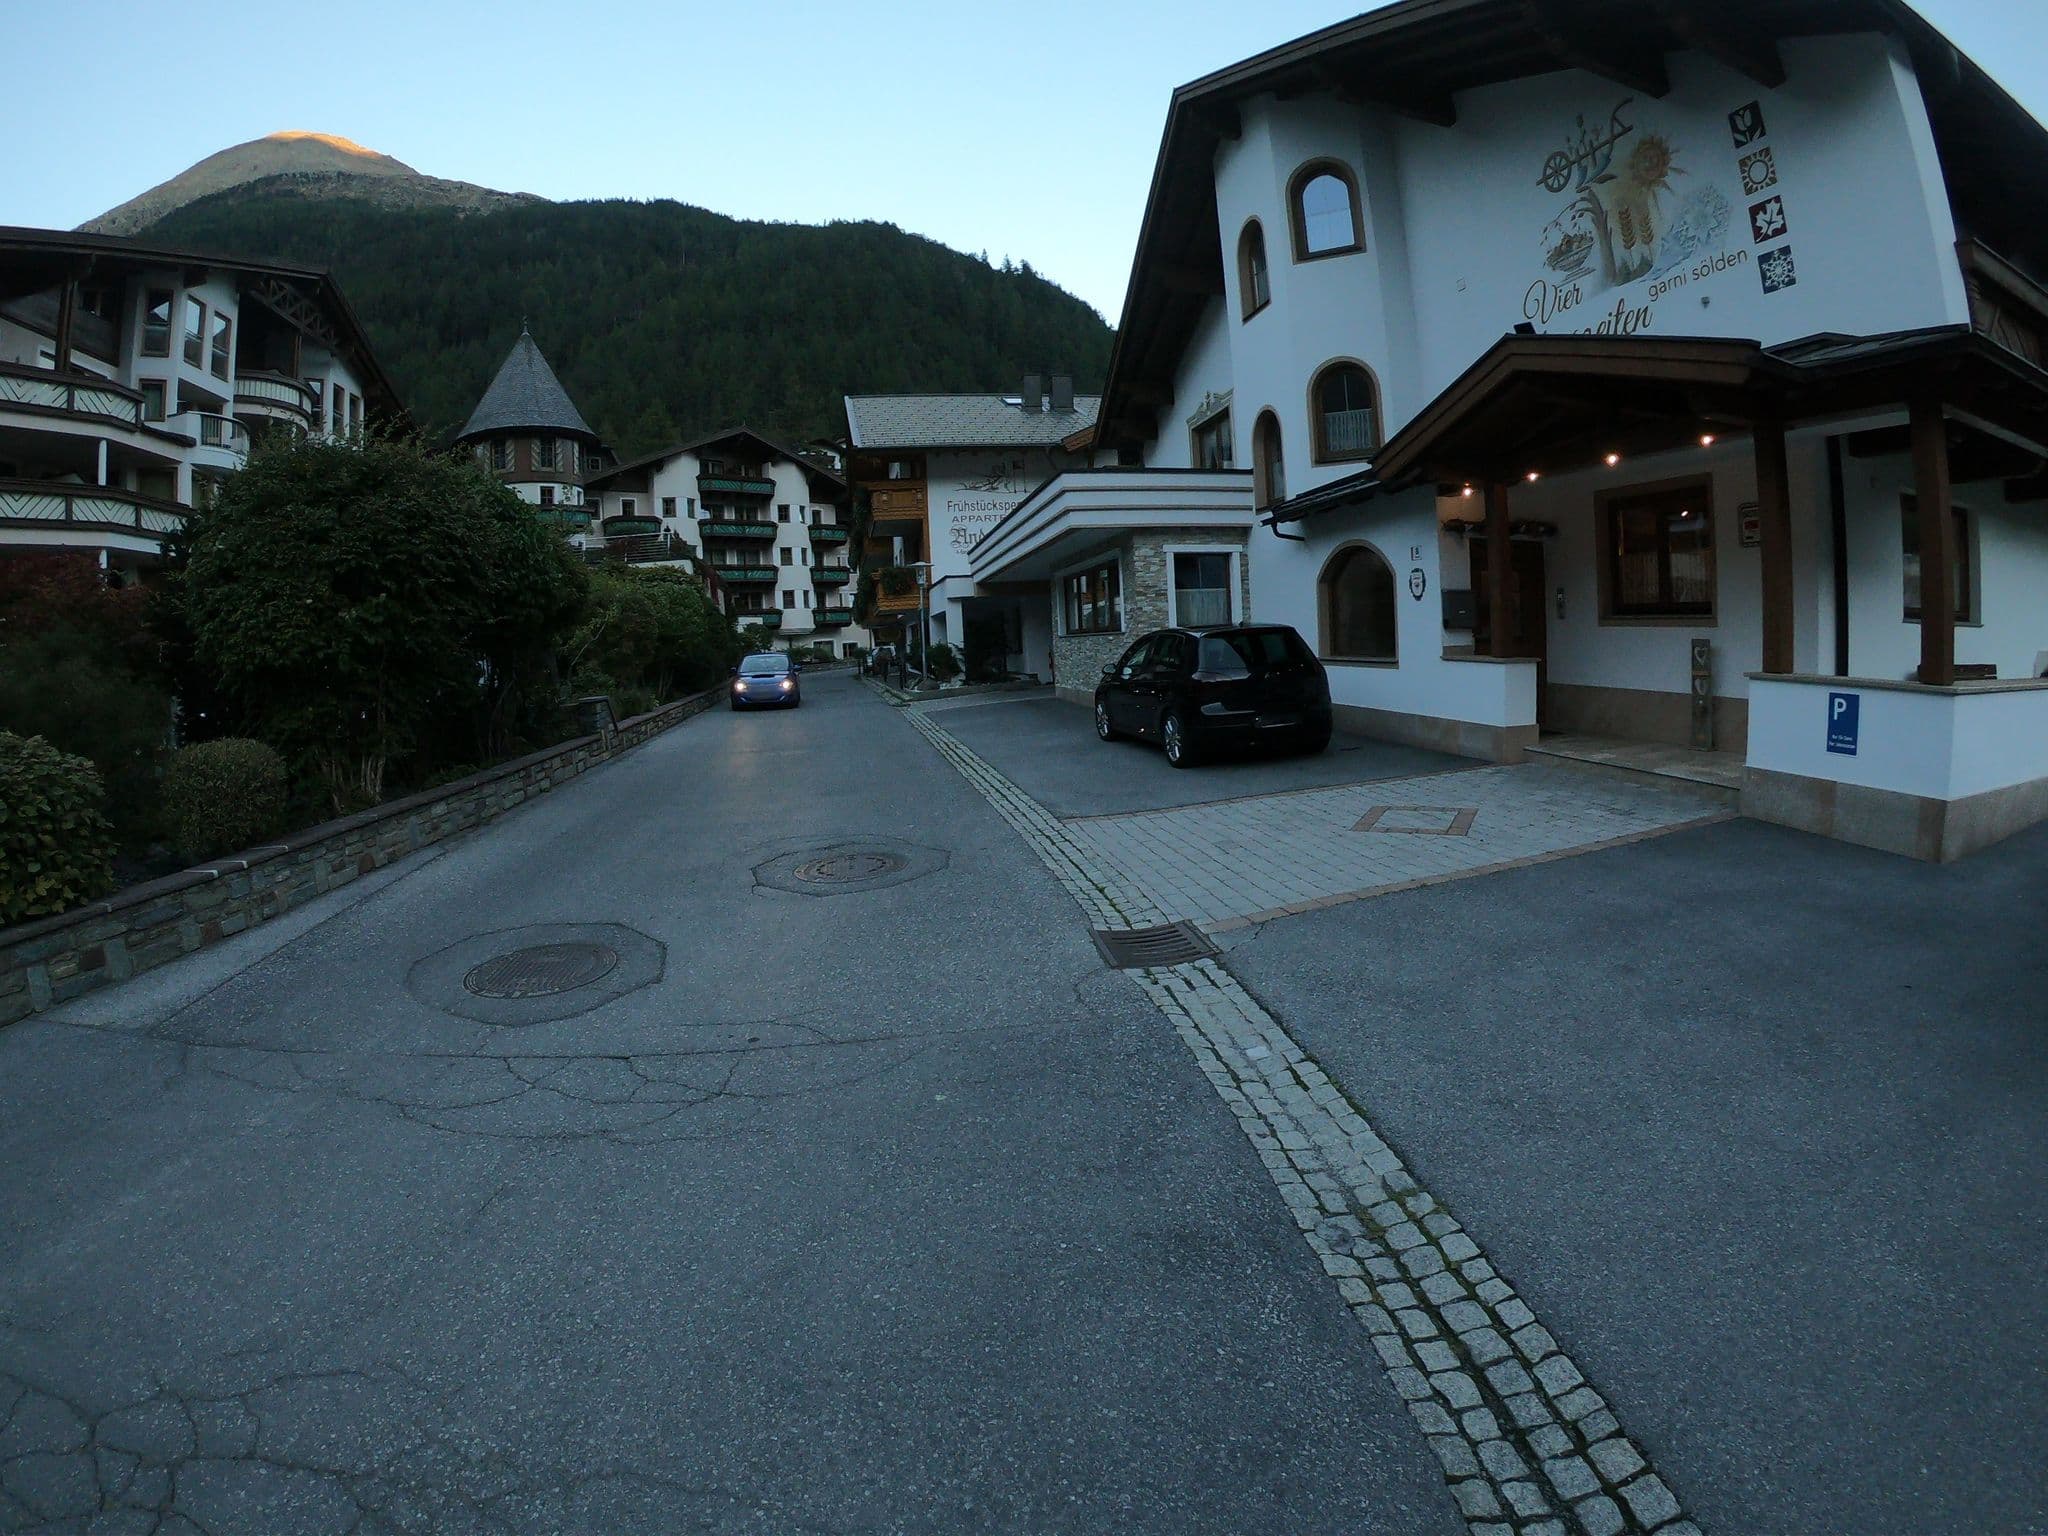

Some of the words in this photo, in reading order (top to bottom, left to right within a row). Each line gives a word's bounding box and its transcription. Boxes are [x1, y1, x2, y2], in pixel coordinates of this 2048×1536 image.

[1648, 272, 1688, 302] garni
[1692, 248, 1748, 281] sölden
[1523, 279, 1583, 325] Vier
[947, 499, 1019, 512] Frühstückspe
[1833, 697, 1847, 721] P
